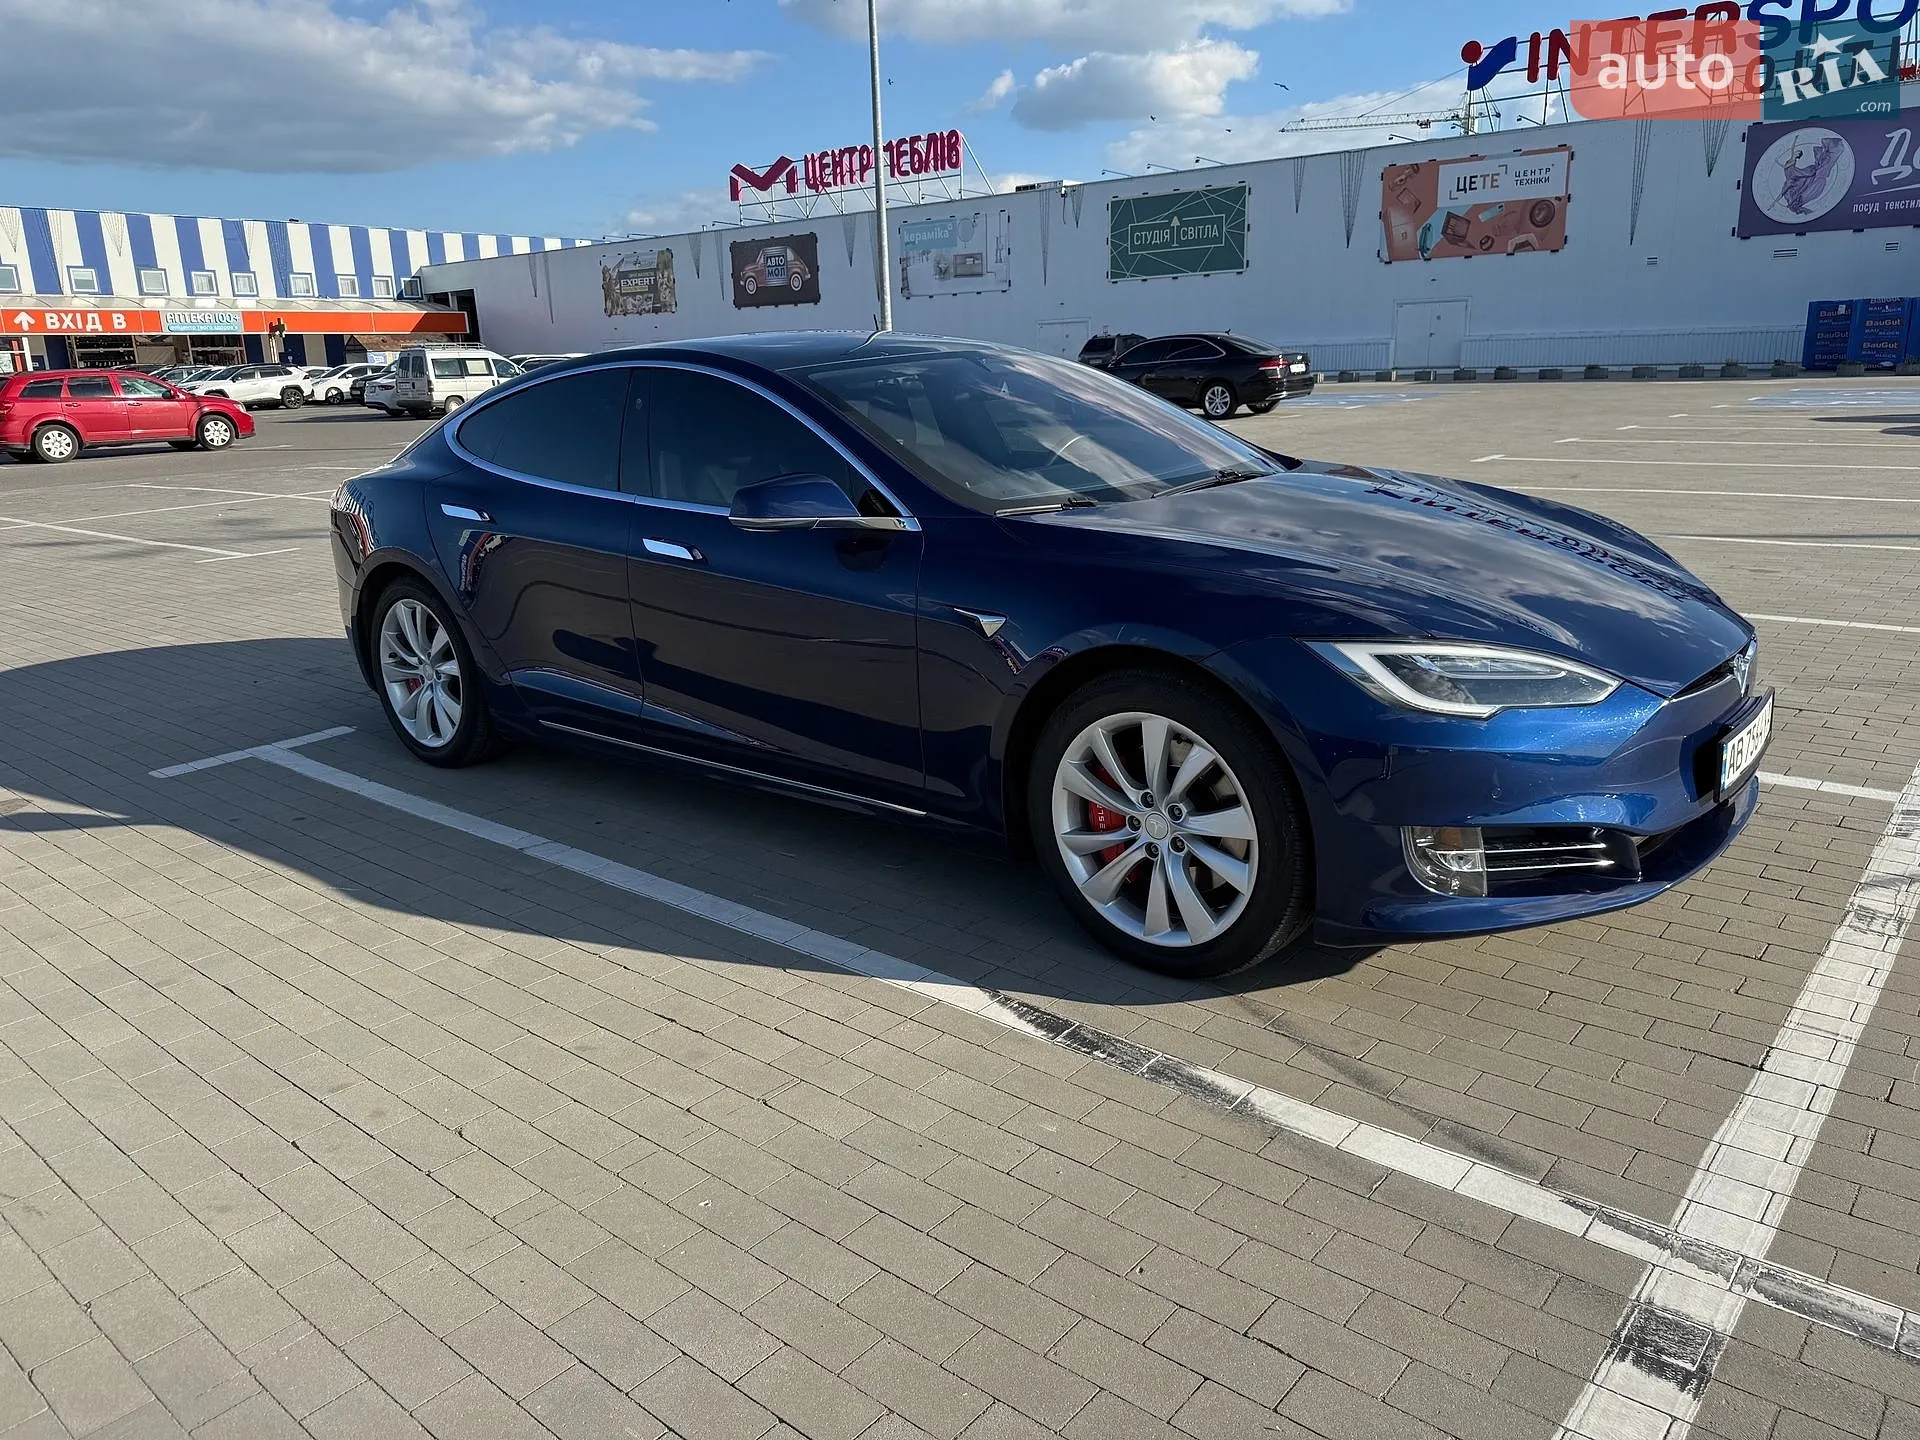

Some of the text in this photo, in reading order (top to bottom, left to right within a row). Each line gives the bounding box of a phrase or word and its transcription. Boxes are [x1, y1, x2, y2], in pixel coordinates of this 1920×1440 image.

[1871, 128, 1920, 185] Д
[803, 143, 873, 194] ЦЕНТР
[1514, 167, 1551, 178] ЦЕНТР
[1455, 172, 1501, 194] ЦЕТЕ
[1514, 176, 1550, 187] ТЕХНІКИ
[1852, 202, 1880, 214] посуд
[1133, 224, 1219, 245] СТУДІЯ СВІТЛА
[766, 256, 785, 266] АВТО
[767, 267, 786, 278] МОЛ
[620, 276, 656, 287] EXPERT
[44, 312, 127, 332] ВХІД В
[166, 311, 213, 324] АПТЕКА
[1096, 804, 1106, 833] ESL
